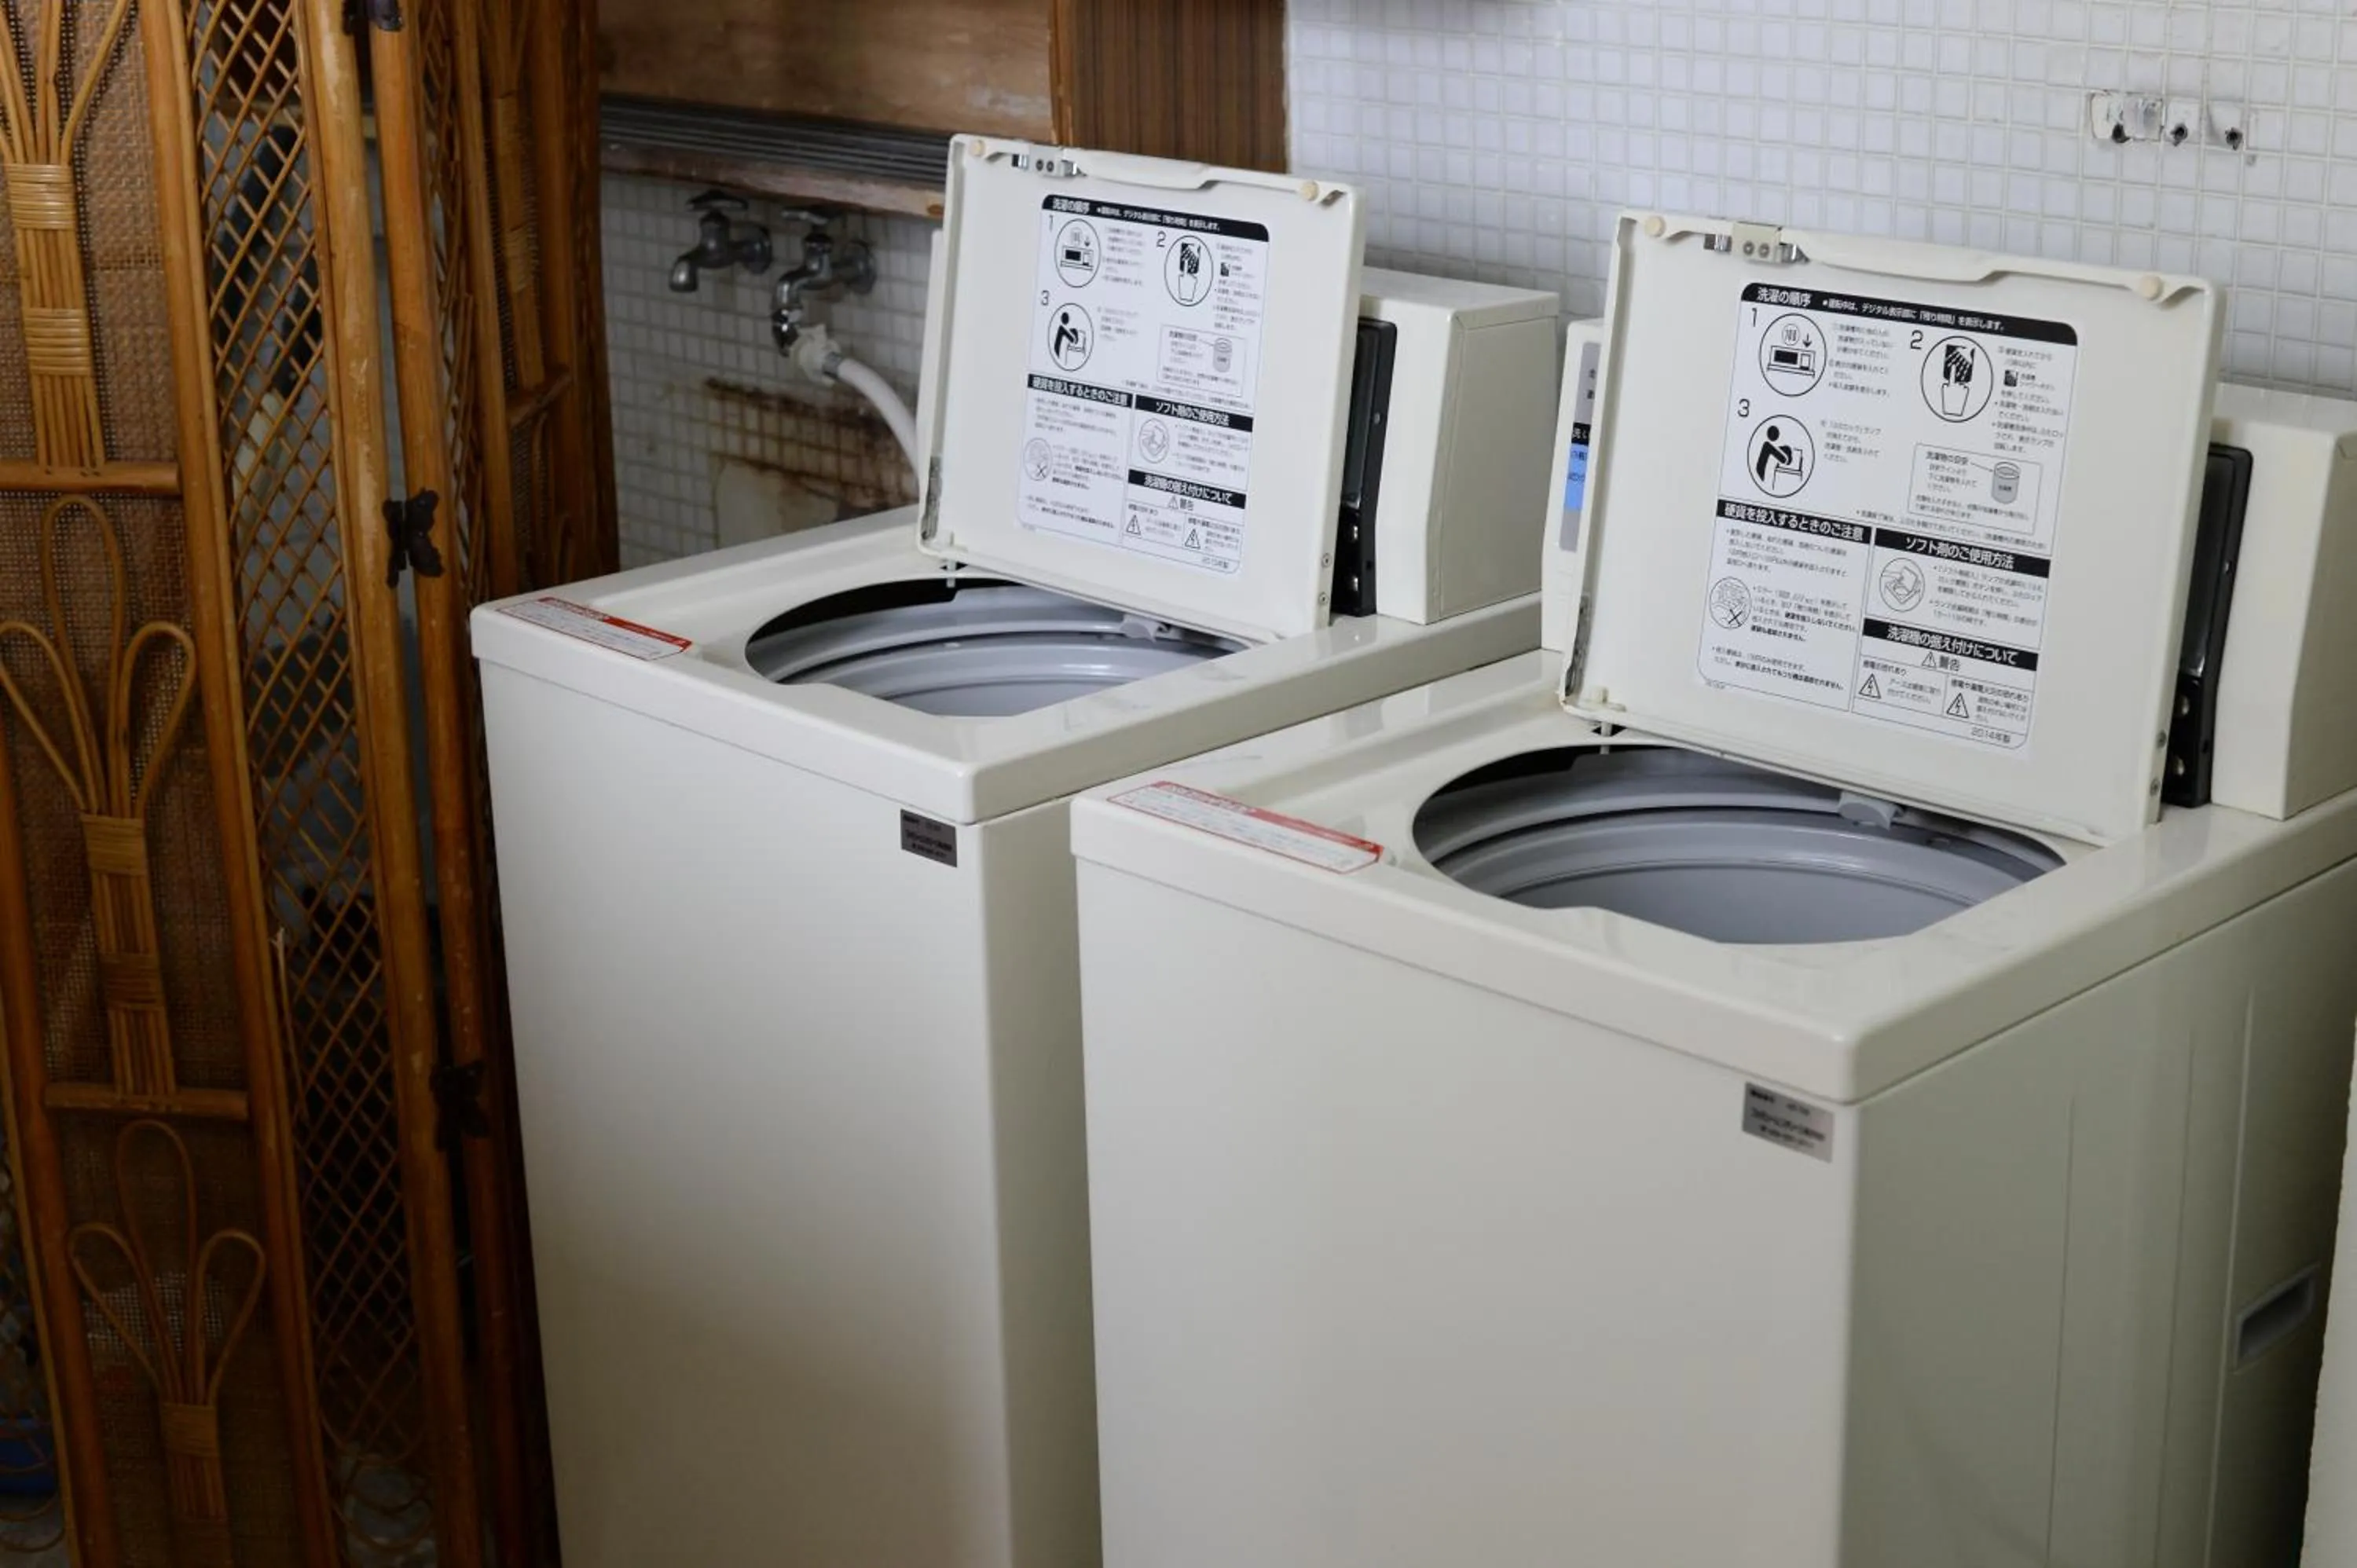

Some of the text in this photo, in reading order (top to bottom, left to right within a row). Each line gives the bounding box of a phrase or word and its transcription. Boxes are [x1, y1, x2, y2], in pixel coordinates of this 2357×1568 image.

[1049, 214, 1054, 232] 1
[1157, 230, 1168, 247] 2
[1041, 290, 1050, 306] 3
[1756, 287, 1813, 307] 洗濯の順序
[1751, 307, 1758, 327] 1
[1910, 330, 1923, 350] 2
[1737, 398, 1750, 417] 3
[1725, 503, 1864, 541] 硬貨を投入するときのご注意
[1905, 537, 2015, 570] ソフト剤のご使用方法
[1886, 625, 2018, 665] 洗濯機の据え付けについて
